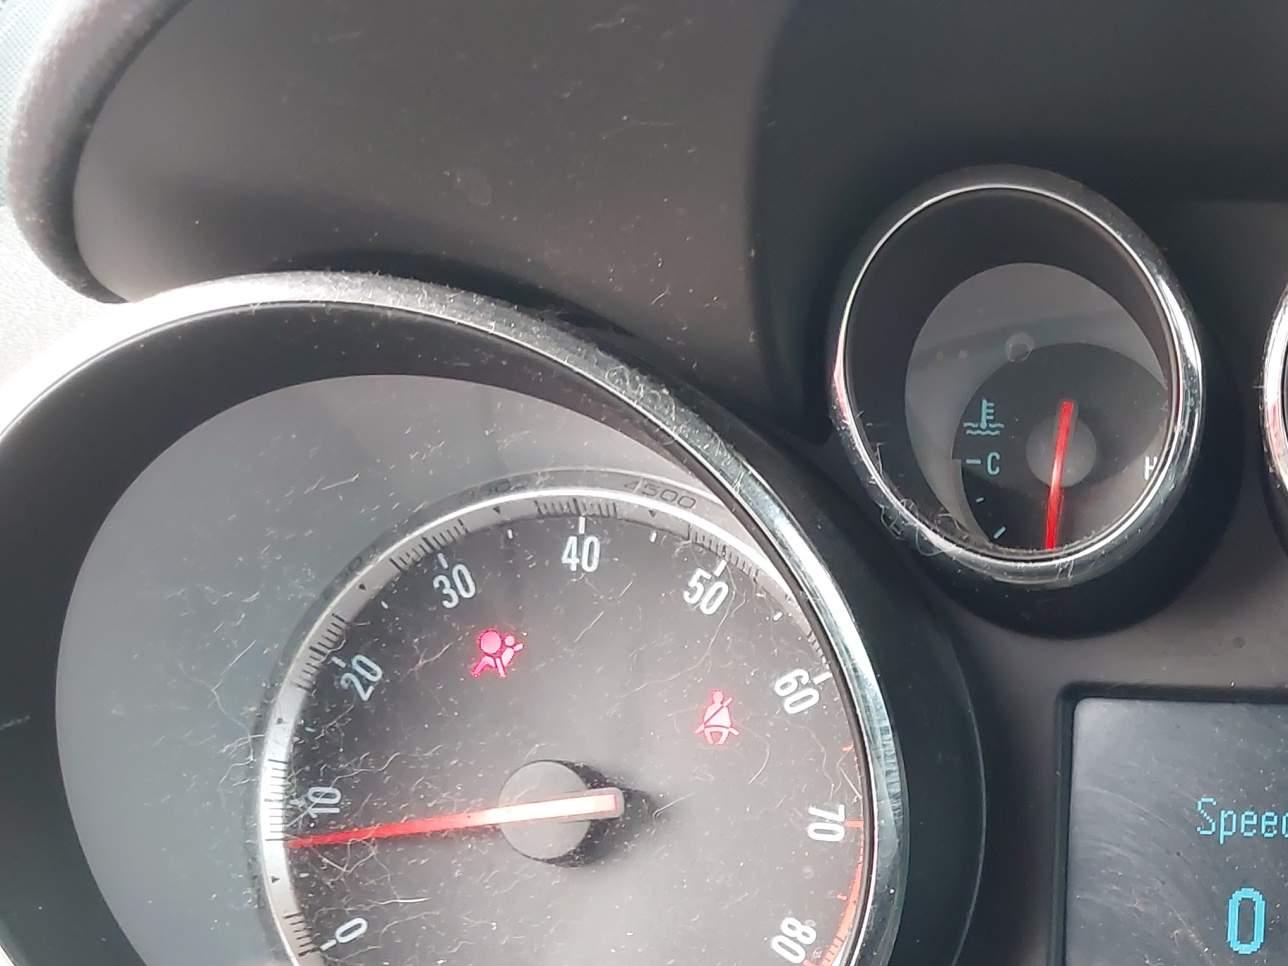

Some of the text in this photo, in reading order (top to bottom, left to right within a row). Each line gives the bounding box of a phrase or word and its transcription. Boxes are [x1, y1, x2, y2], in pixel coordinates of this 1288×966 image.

[987, 452, 1000, 475] C
[1144, 456, 1158, 480] H
[562, 536, 601, 573] 40
[433, 564, 477, 609] 30
[683, 575, 729, 615] 50
[340, 654, 382, 701] 20
[774, 668, 819, 714] 60
[307, 786, 341, 818] 10
[807, 804, 845, 841] 70
[335, 918, 368, 943] 0
[1226, 887, 1266, 954] 0
[770, 917, 816, 964] 80
